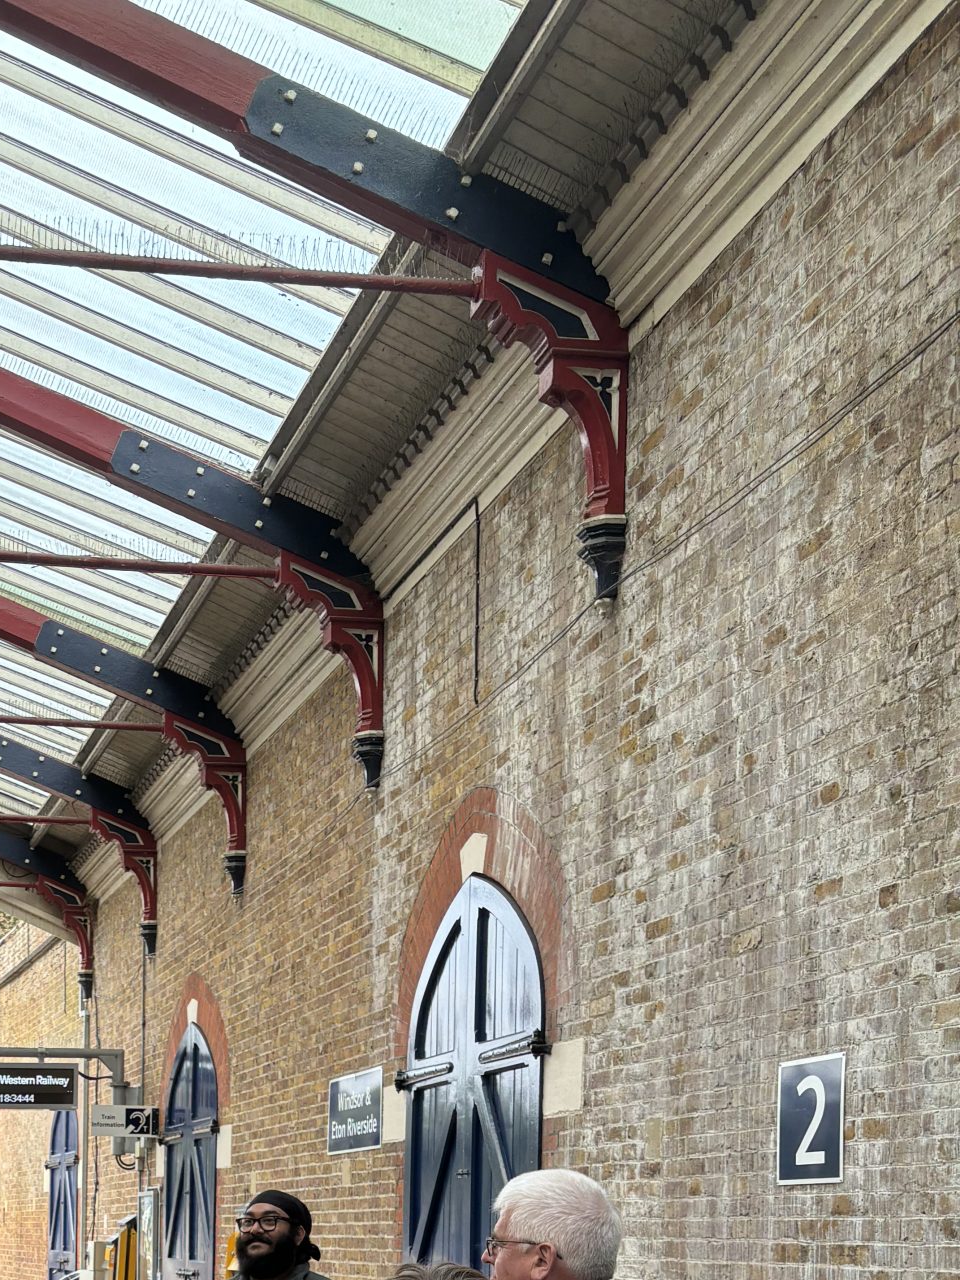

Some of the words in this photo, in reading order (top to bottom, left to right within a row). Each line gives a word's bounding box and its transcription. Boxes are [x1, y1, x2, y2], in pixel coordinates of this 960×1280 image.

[0, 1074, 35, 1085] Western
[36, 1075, 70, 1088] Railway
[0, 1093, 35, 1103] 18:34:44
[337, 1090, 365, 1112] Windsor
[365, 1086, 372, 1106] &
[331, 1120, 346, 1140] Eton
[346, 1113, 378, 1137] Riverside
[795, 1074, 826, 1166] 2
